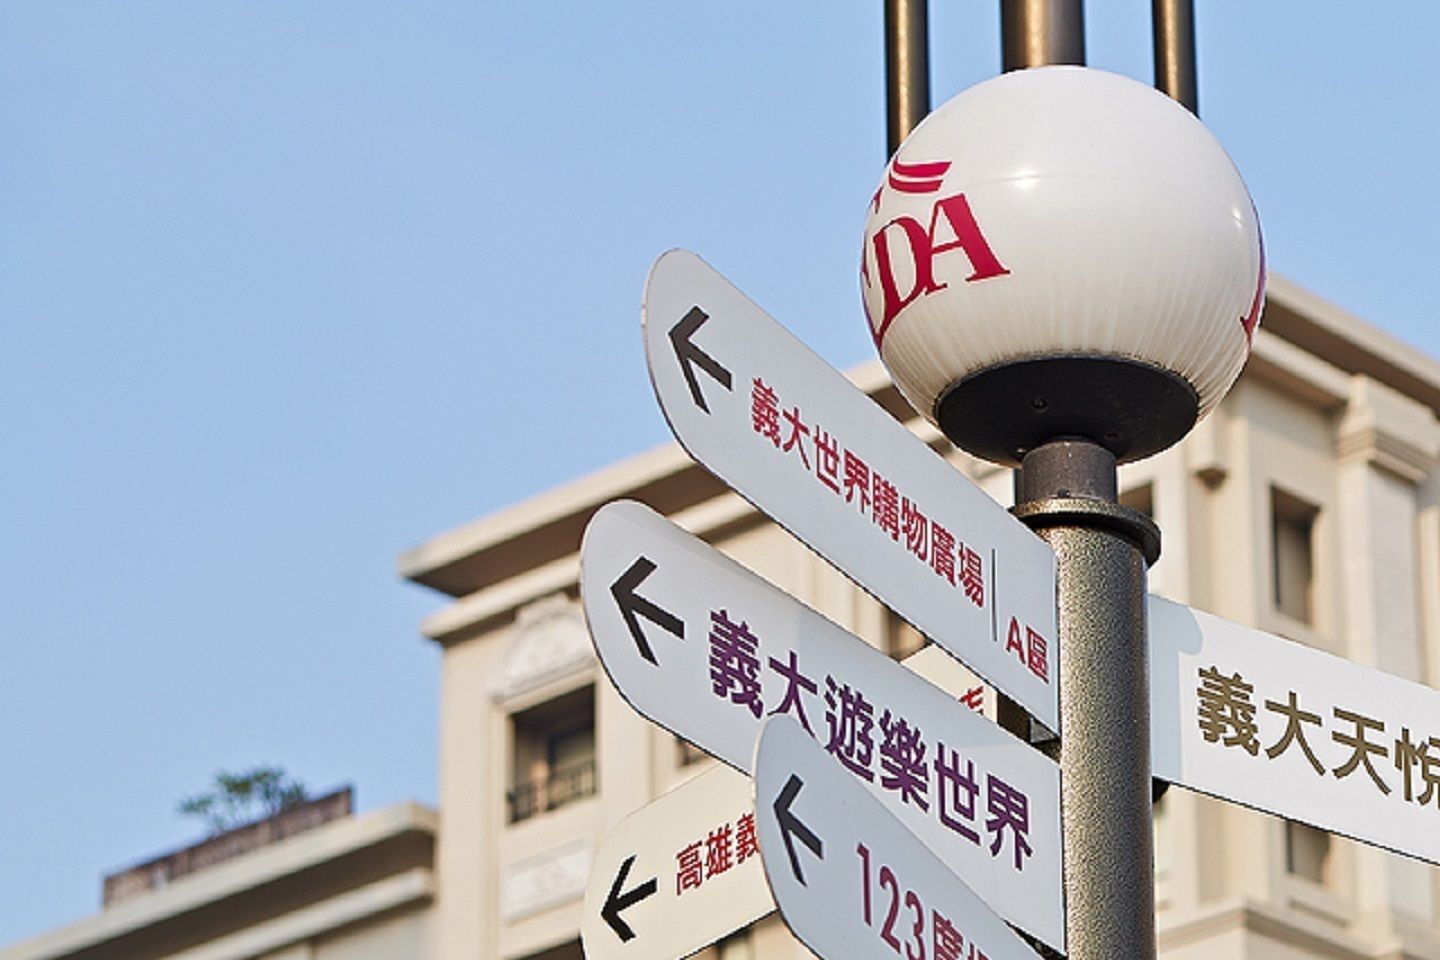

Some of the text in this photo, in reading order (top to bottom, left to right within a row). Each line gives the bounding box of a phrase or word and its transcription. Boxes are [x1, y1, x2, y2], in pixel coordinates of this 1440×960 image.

[863, 193, 1011, 350] DA
[751, 377, 1050, 685] 義大世界購物廣場 A區
[709, 609, 1034, 872] 義大遊樂世界
